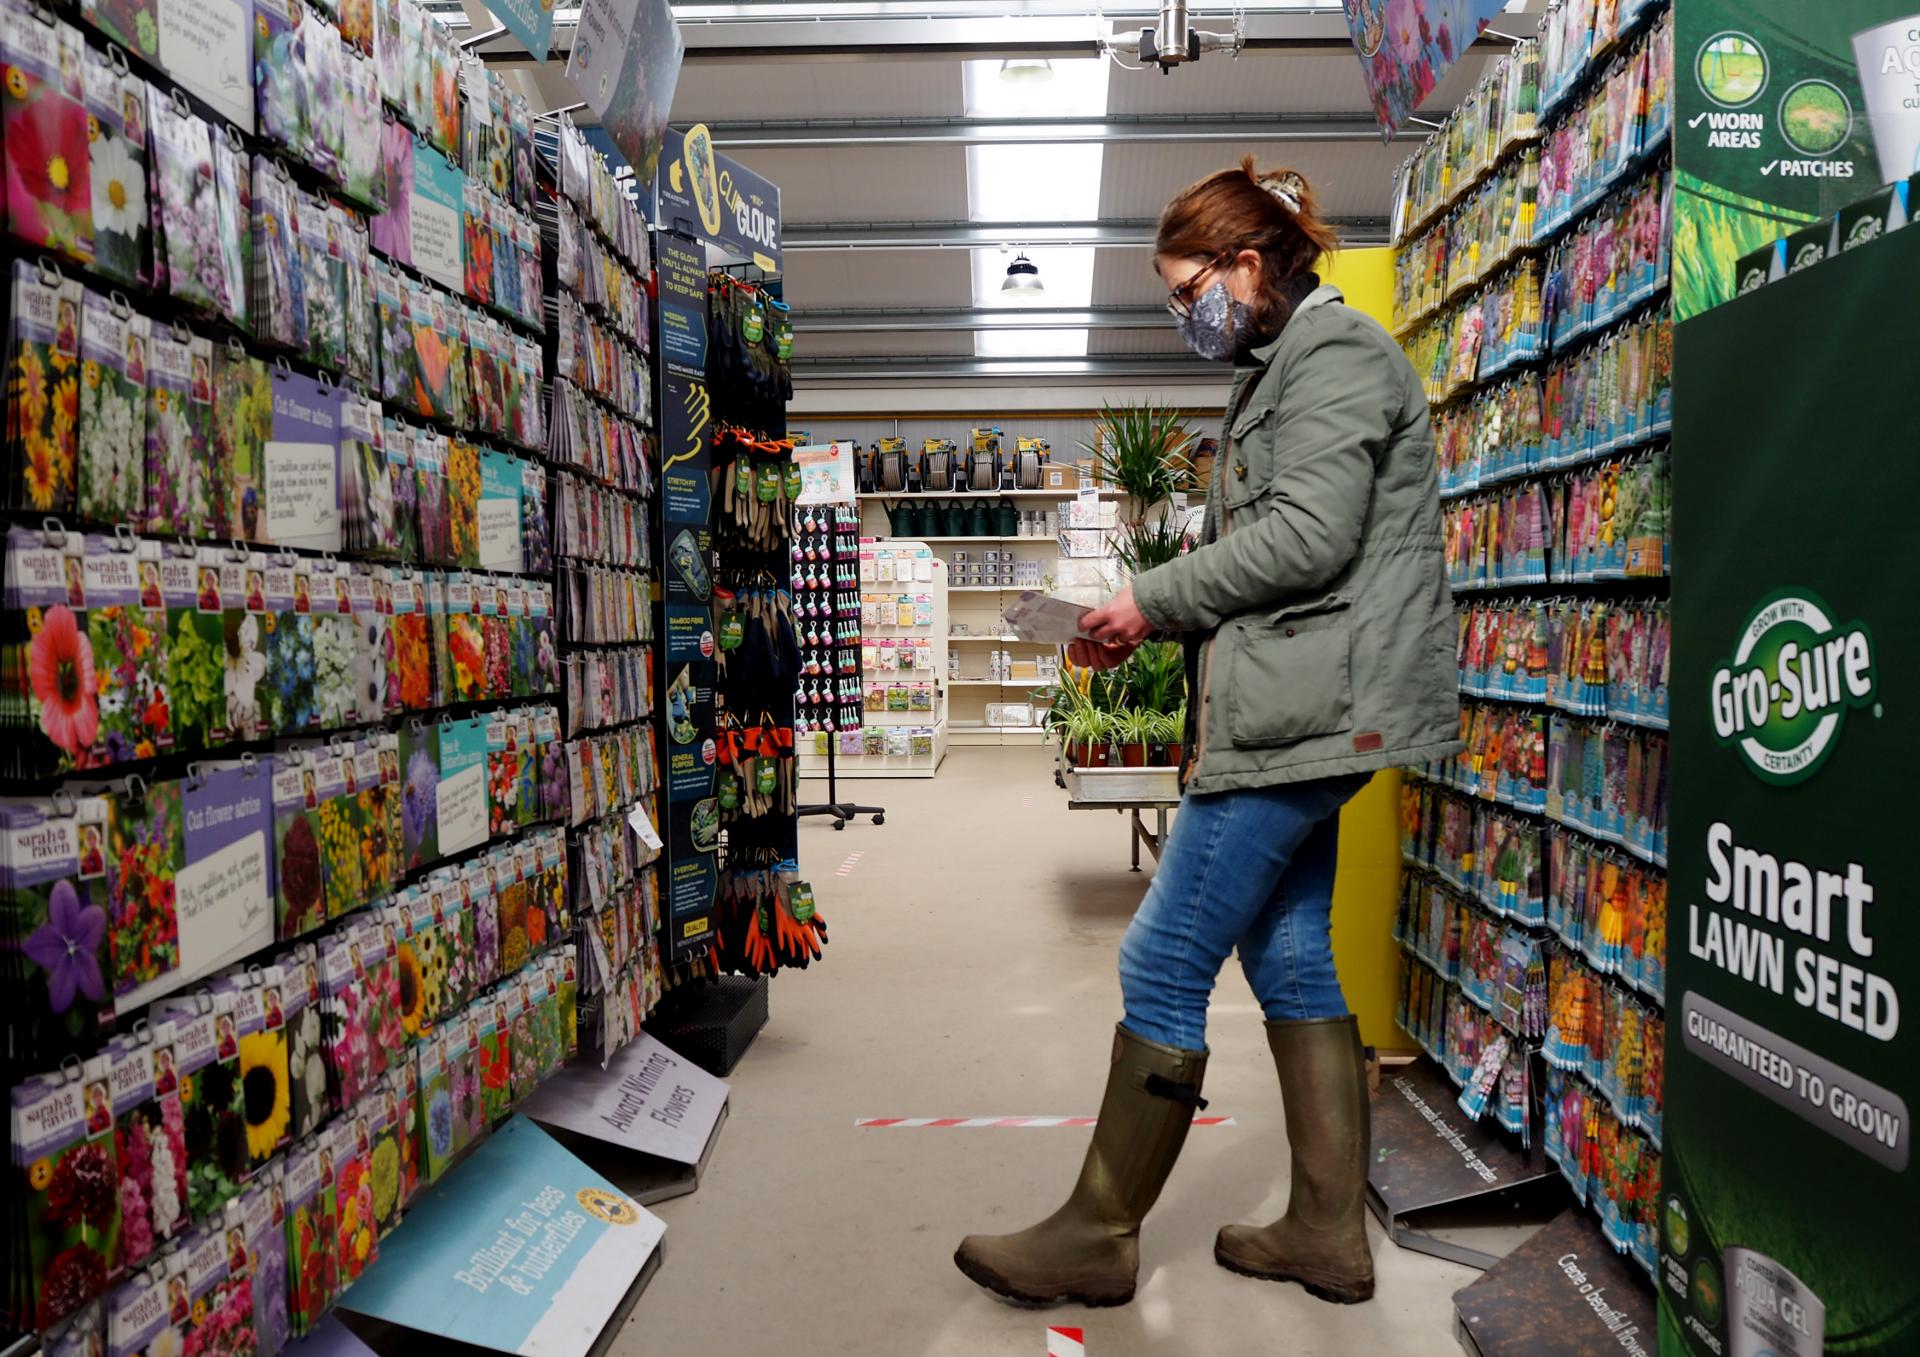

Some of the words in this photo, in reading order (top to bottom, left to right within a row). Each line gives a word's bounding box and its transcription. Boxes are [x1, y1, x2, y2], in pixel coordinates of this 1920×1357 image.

[583, 2, 606, 43] Flowers
[1708, 113, 1763, 130] WORN
[1708, 131, 1761, 149] AREAS
[1780, 160, 1854, 178] PATCHES
[735, 201, 777, 250] GLOVE
[661, 256, 682, 271] YOU'LL
[682, 262, 706, 280] ALWAYS
[667, 247, 679, 259] THE
[679, 251, 699, 266] GLOVE
[665, 280, 674, 289] TO
[674, 283, 689, 296] KEEP
[689, 288, 705, 301] SAFE
[672, 271, 681, 281] BE
[681, 275, 696, 287] ABLE
[274, 394, 289, 416] Cut
[289, 398, 312, 423] flower
[312, 406, 334, 429] advice
[100, 573, 133, 585] raven
[1752, 606, 1779, 638] GROW
[1779, 602, 1805, 619] WITH
[1711, 630, 1872, 738] Gro-Sure
[1763, 743, 1815, 771] CERTAINTY
[187, 809, 205, 832] Cut
[205, 805, 234, 827] flower
[235, 797, 261, 819] advice
[17, 828, 57, 849] sarah
[31, 842, 71, 859] raven
[674, 862, 699, 876] EVERYDAY
[1706, 821, 1874, 958] Smart
[685, 920, 706, 934] QUALITY
[1688, 903, 1785, 996] LAWN
[1794, 947, 1900, 1042] SEED
[600, 1082, 642, 1133] Award
[632, 1051, 678, 1107] Winning
[1687, 1010, 1794, 1090] GUARANTEED
[1797, 1067, 1825, 1108] TO
[1829, 1088, 1901, 1149] GROW
[26, 1097, 63, 1122] sarah
[41, 1107, 77, 1131] raven
[649, 1084, 696, 1129] Flowers
[1461, 1147, 1478, 1161] the
[1465, 1159, 1498, 1184] garden
[453, 1216, 528, 1294] Brilliant
[508, 1206, 543, 1237] for
[530, 1184, 567, 1218] bees
[499, 1270, 531, 1296] &
[518, 1208, 587, 1280] butterflies
[1558, 1253, 1588, 1286] Create
[1579, 1284, 1594, 1294] a
[1736, 1265, 1779, 1315] AQUA
[1780, 1296, 1811, 1336] GEL
[1585, 1287, 1633, 1333] beautiful
[1616, 1326, 1651, 1357] flowe
